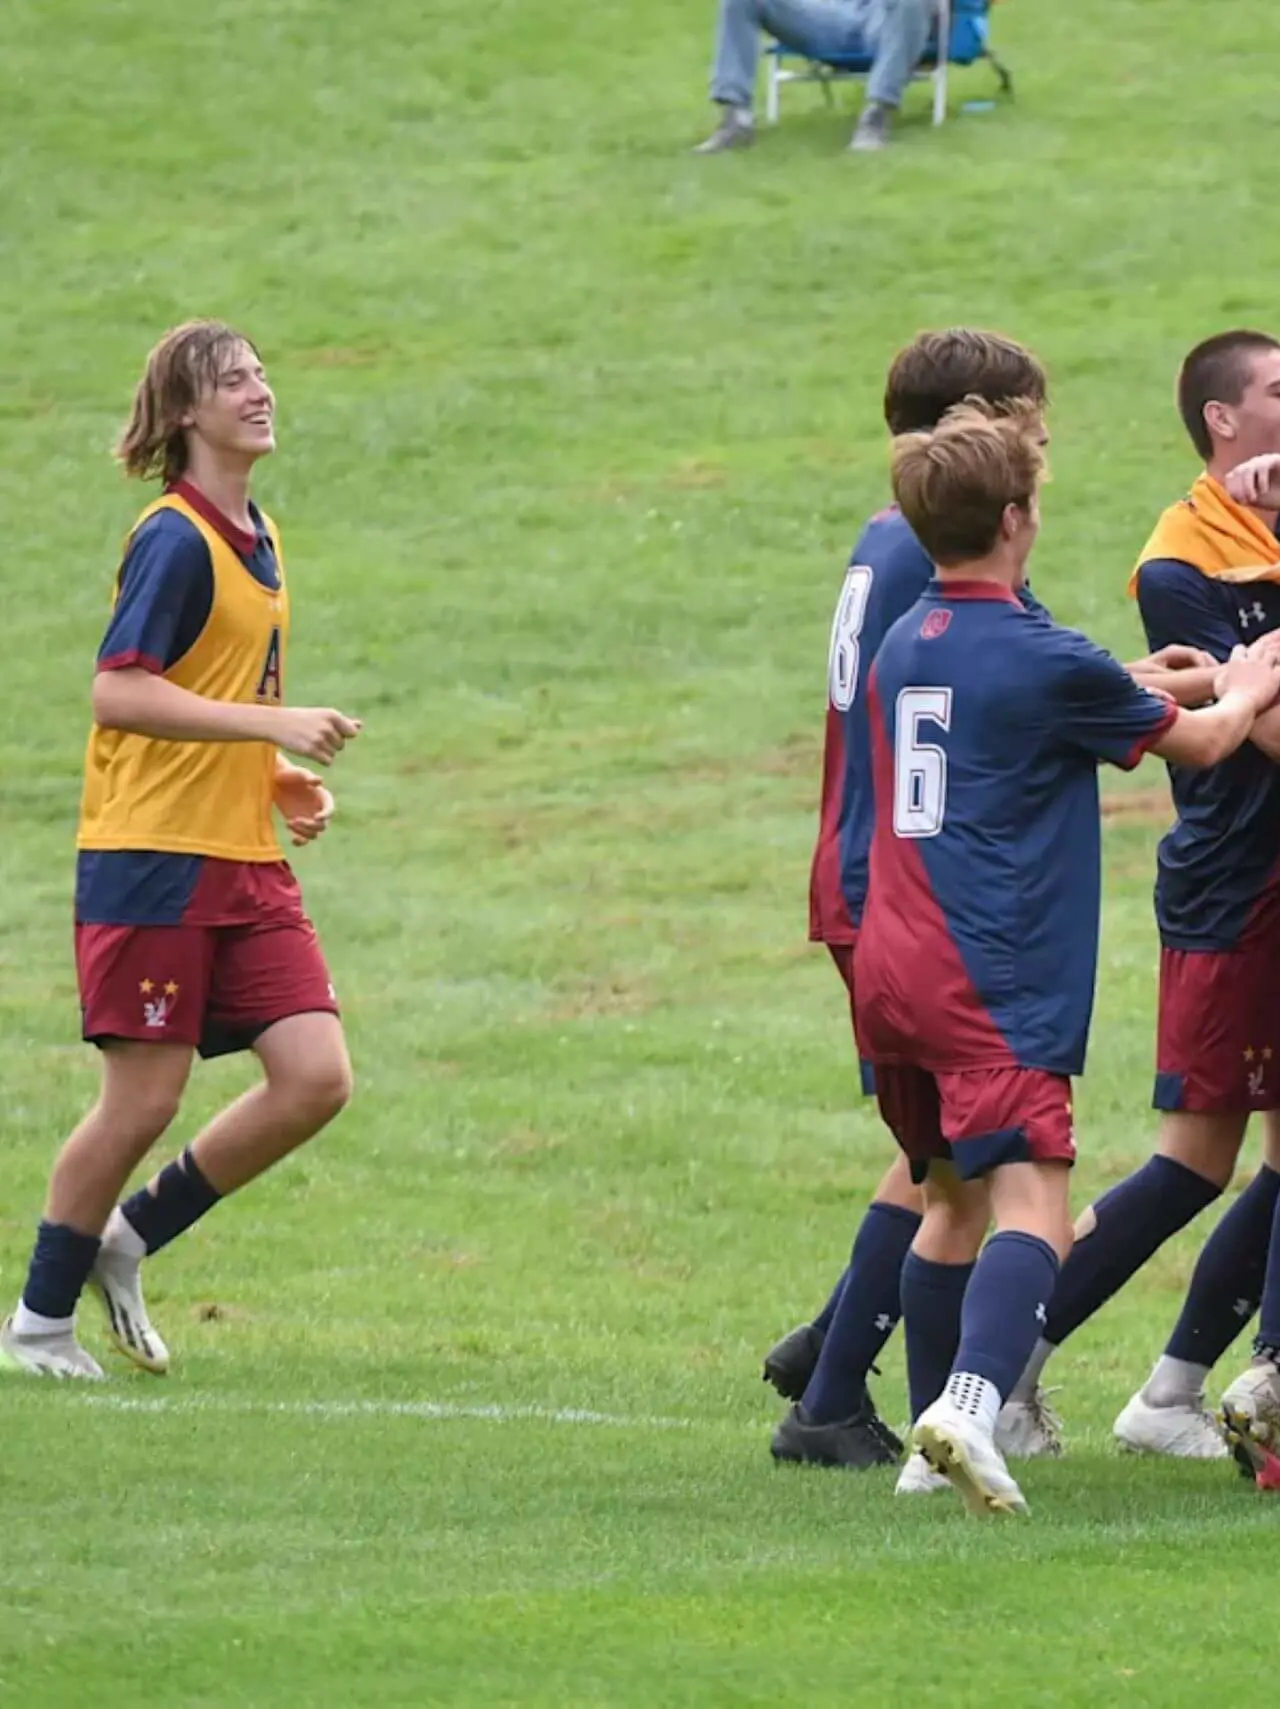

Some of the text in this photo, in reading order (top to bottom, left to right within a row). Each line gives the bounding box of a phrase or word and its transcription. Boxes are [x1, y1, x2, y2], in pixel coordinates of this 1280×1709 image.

[256, 625, 281, 699] A
[828, 565, 873, 712] 8
[893, 686, 953, 838] 6
